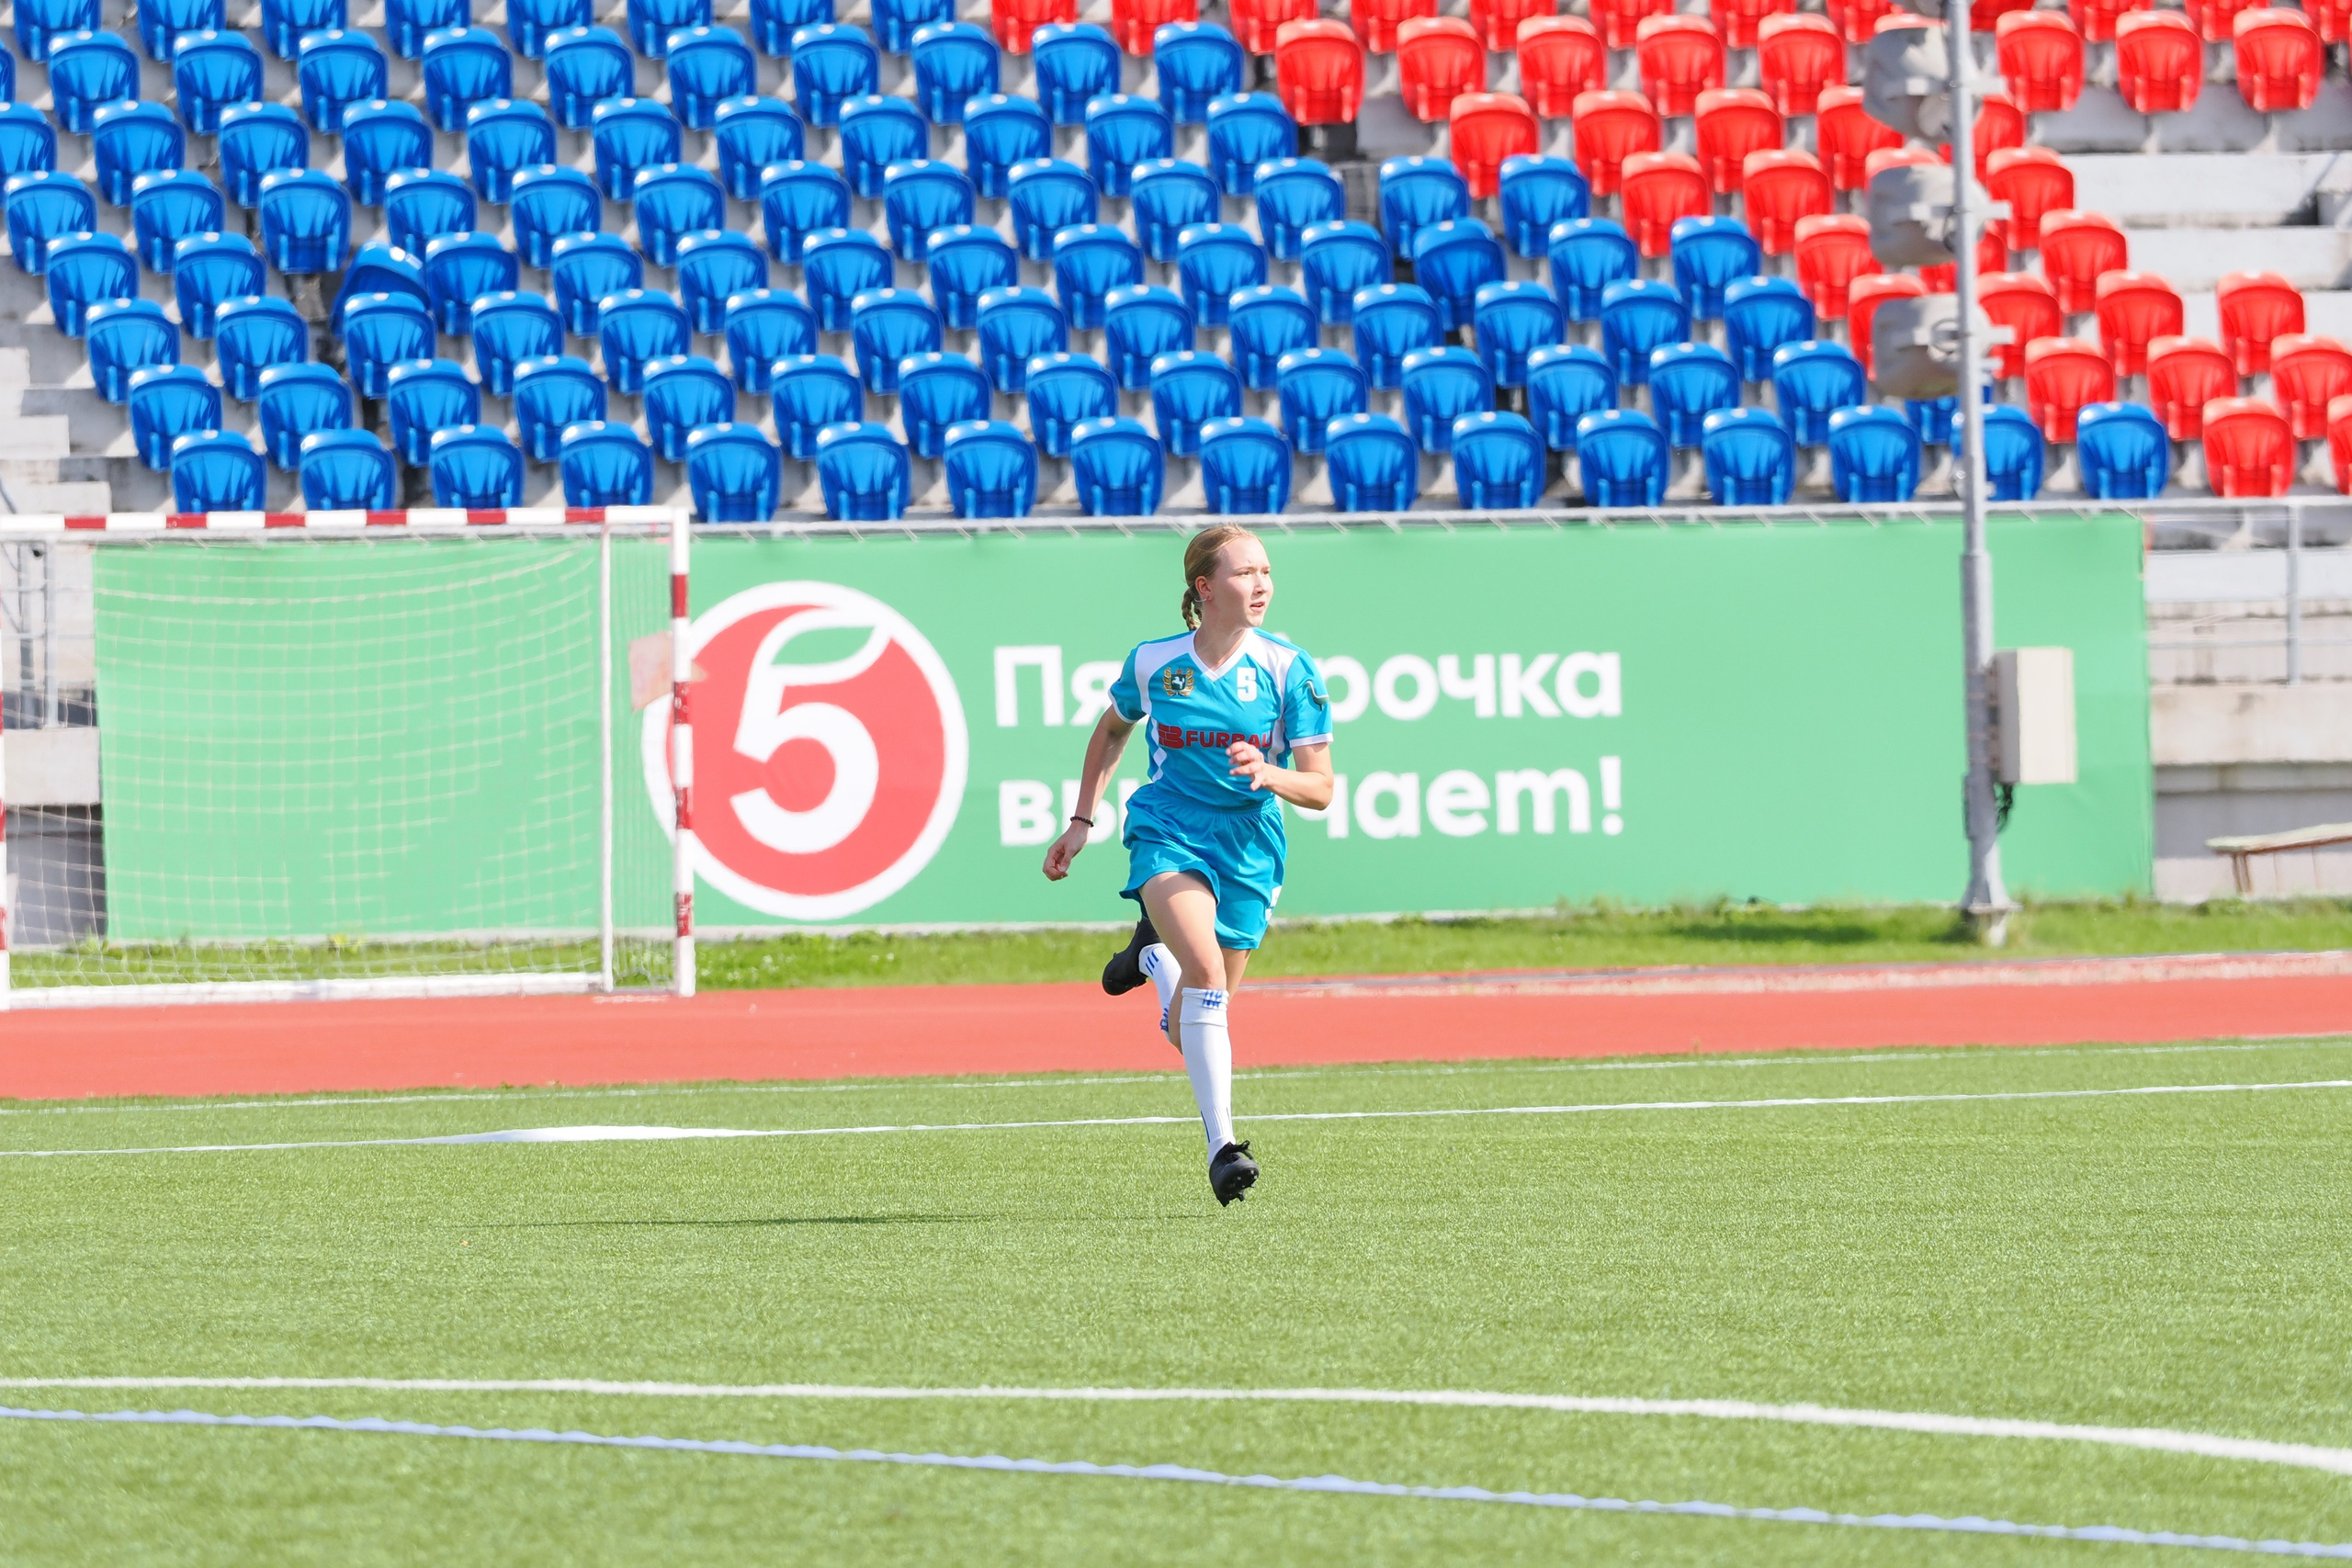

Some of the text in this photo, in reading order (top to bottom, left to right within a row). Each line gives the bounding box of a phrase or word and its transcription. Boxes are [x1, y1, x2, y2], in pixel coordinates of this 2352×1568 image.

[994, 632, 1622, 727] Пярочка
[1237, 667, 1257, 702] 5
[730, 606, 892, 854] 5
